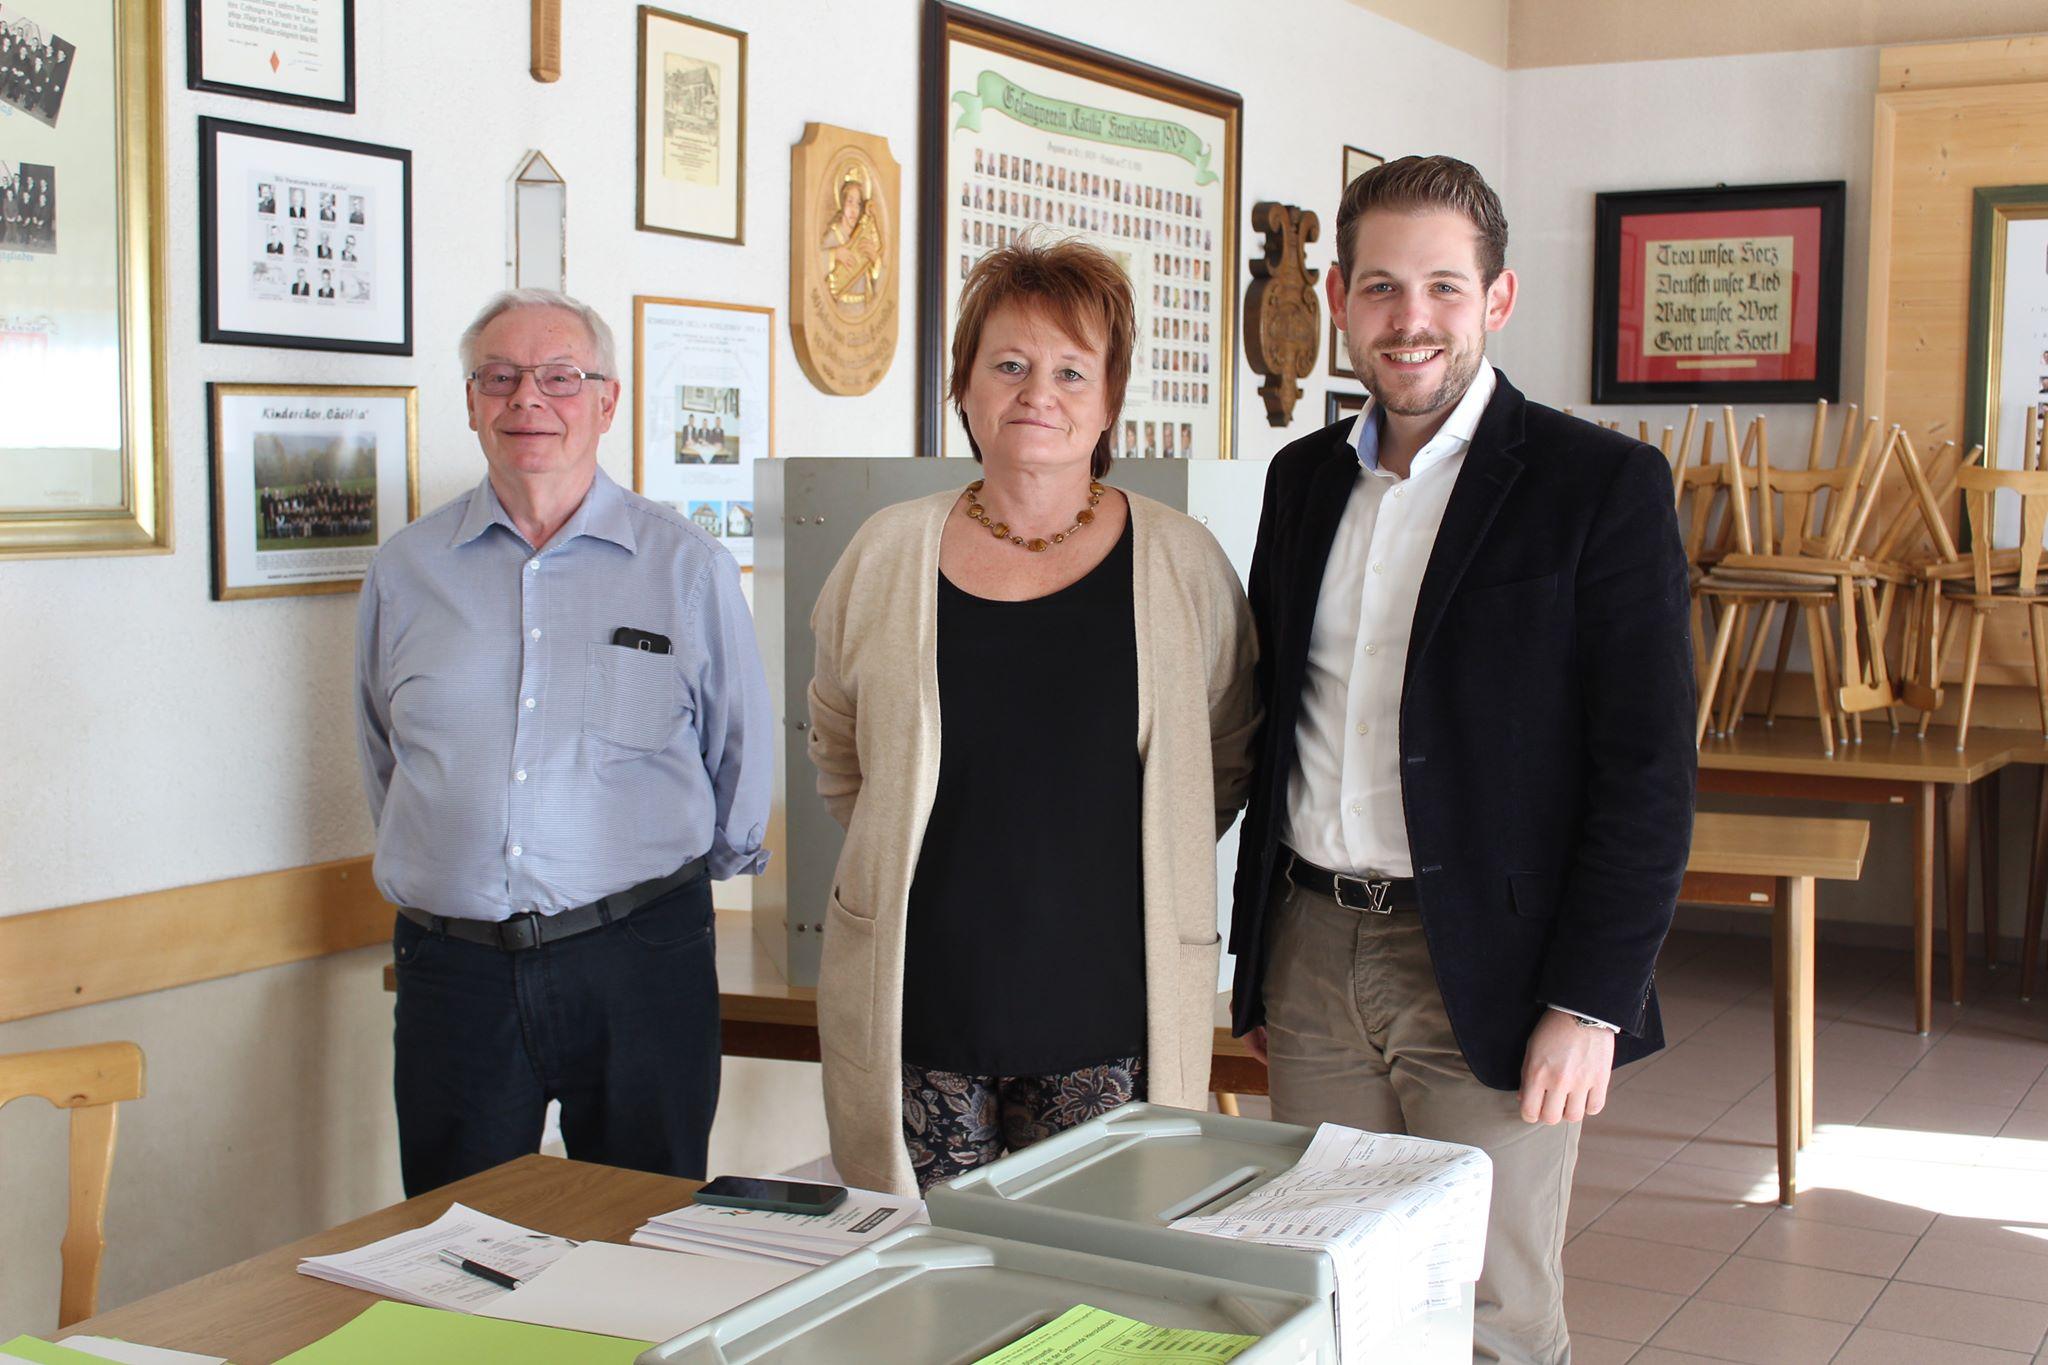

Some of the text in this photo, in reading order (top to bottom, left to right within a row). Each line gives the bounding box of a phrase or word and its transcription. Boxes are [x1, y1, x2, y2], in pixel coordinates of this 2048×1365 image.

[1657, 244, 1695, 266] Treu
[1741, 241, 1779, 267] Herz
[1656, 273, 1712, 297] Deutsch
[1747, 271, 1781, 292] Lied
[1655, 301, 1697, 327] Wahr
[1738, 300, 1779, 322] Wort
[1654, 331, 1693, 352] Gott
